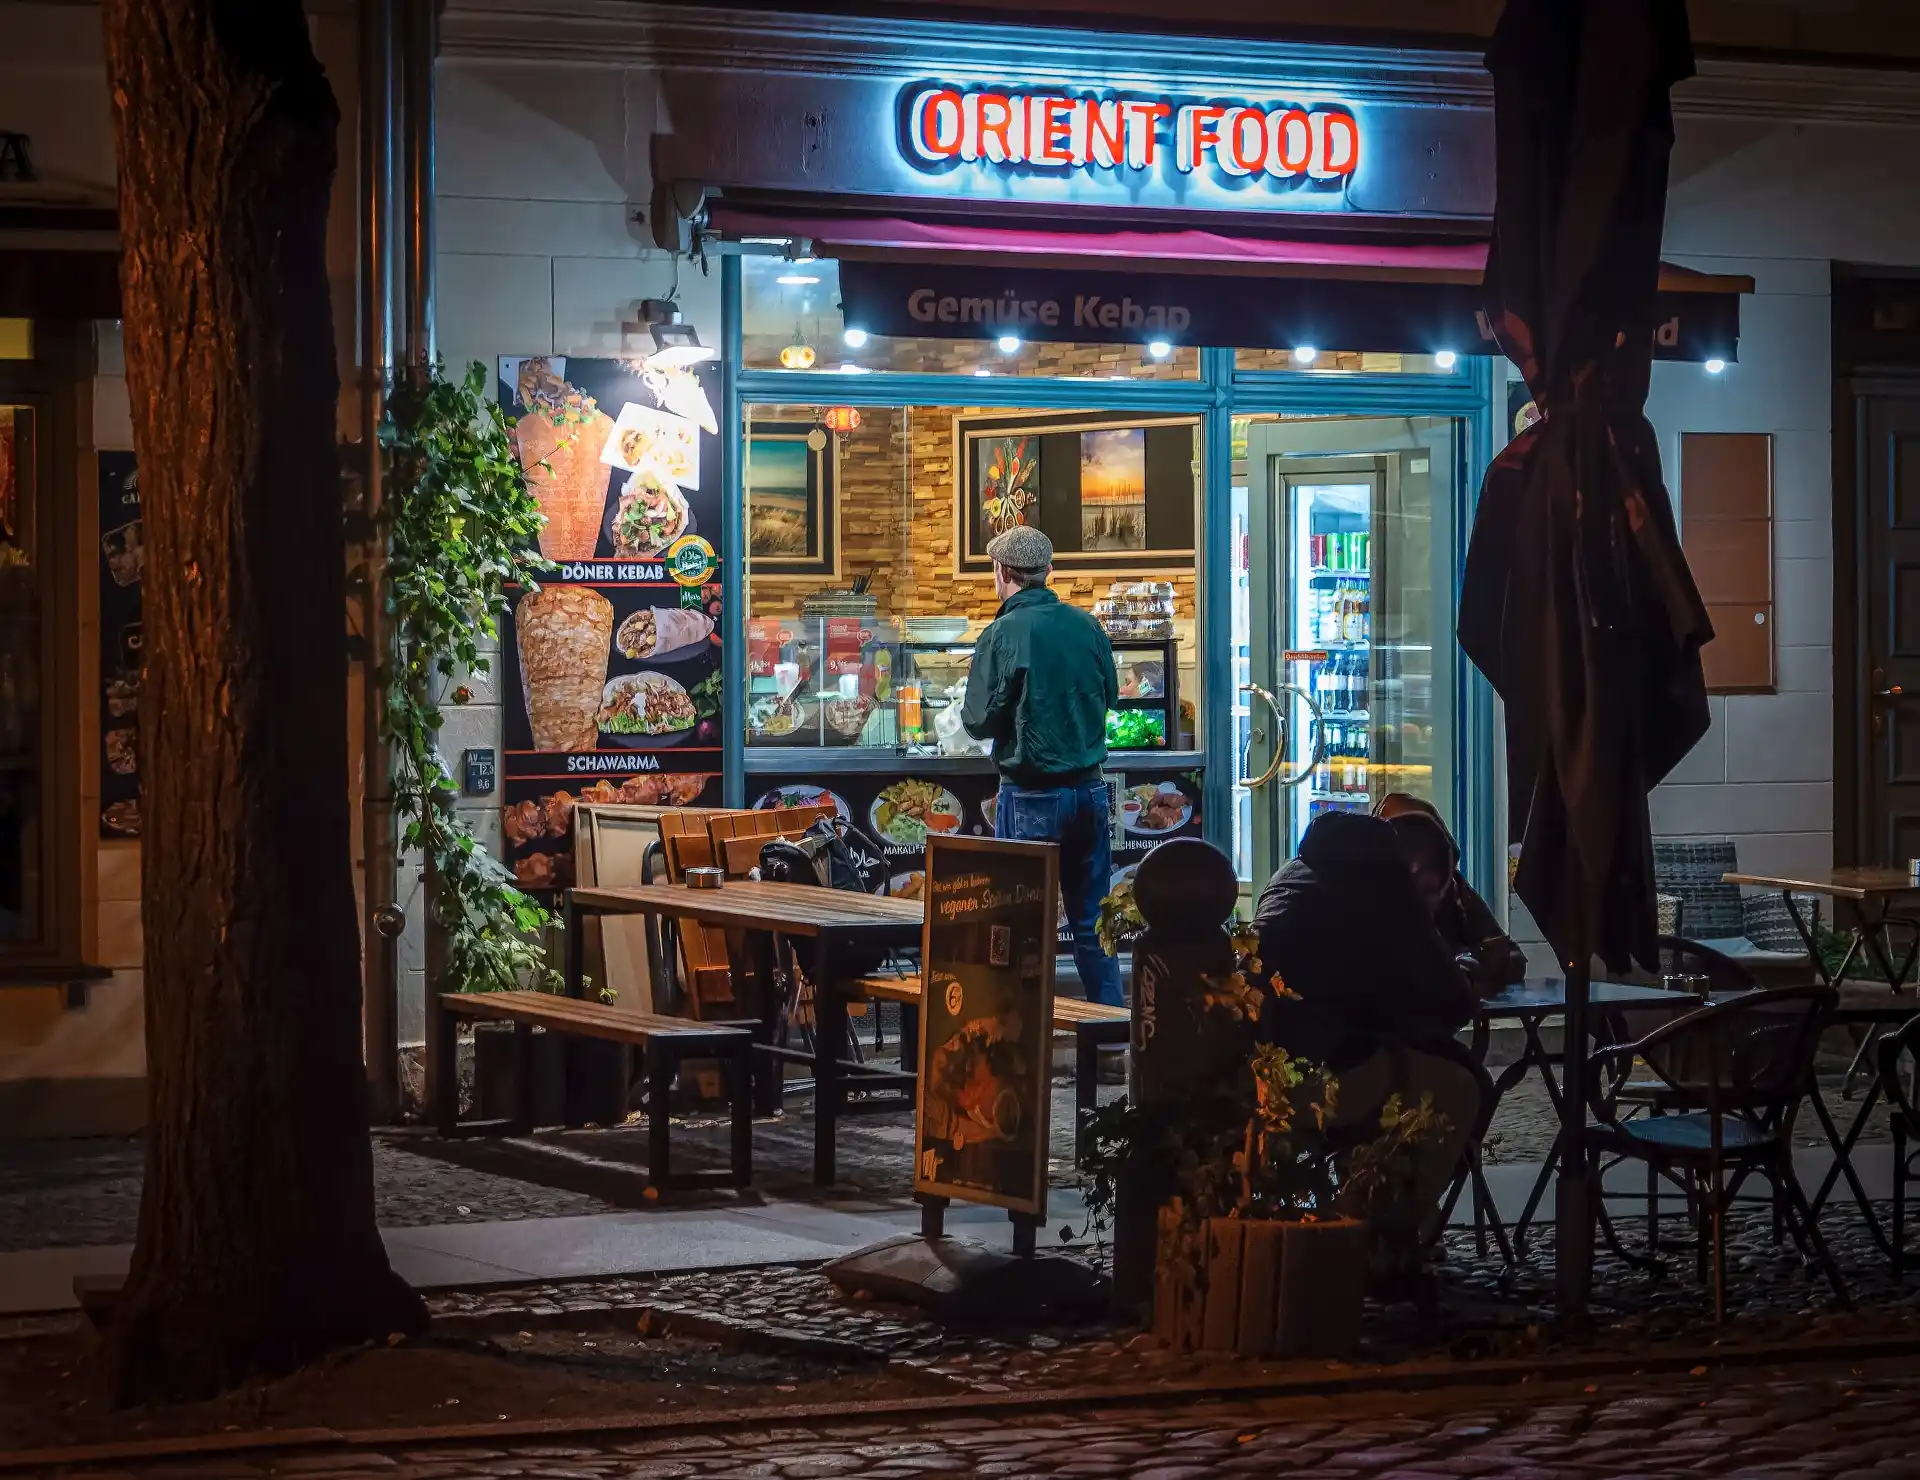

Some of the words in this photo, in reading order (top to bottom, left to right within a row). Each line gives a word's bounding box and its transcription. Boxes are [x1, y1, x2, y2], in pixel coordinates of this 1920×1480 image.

[911, 88, 1171, 170] ORIENT
[1176, 105, 1359, 180] FOOD
[908, 288, 1061, 326] Gemüse
[562, 561, 614, 580] DÖNER
[618, 564, 664, 581] KEBAB
[567, 755, 660, 772] SCHAWARMA
